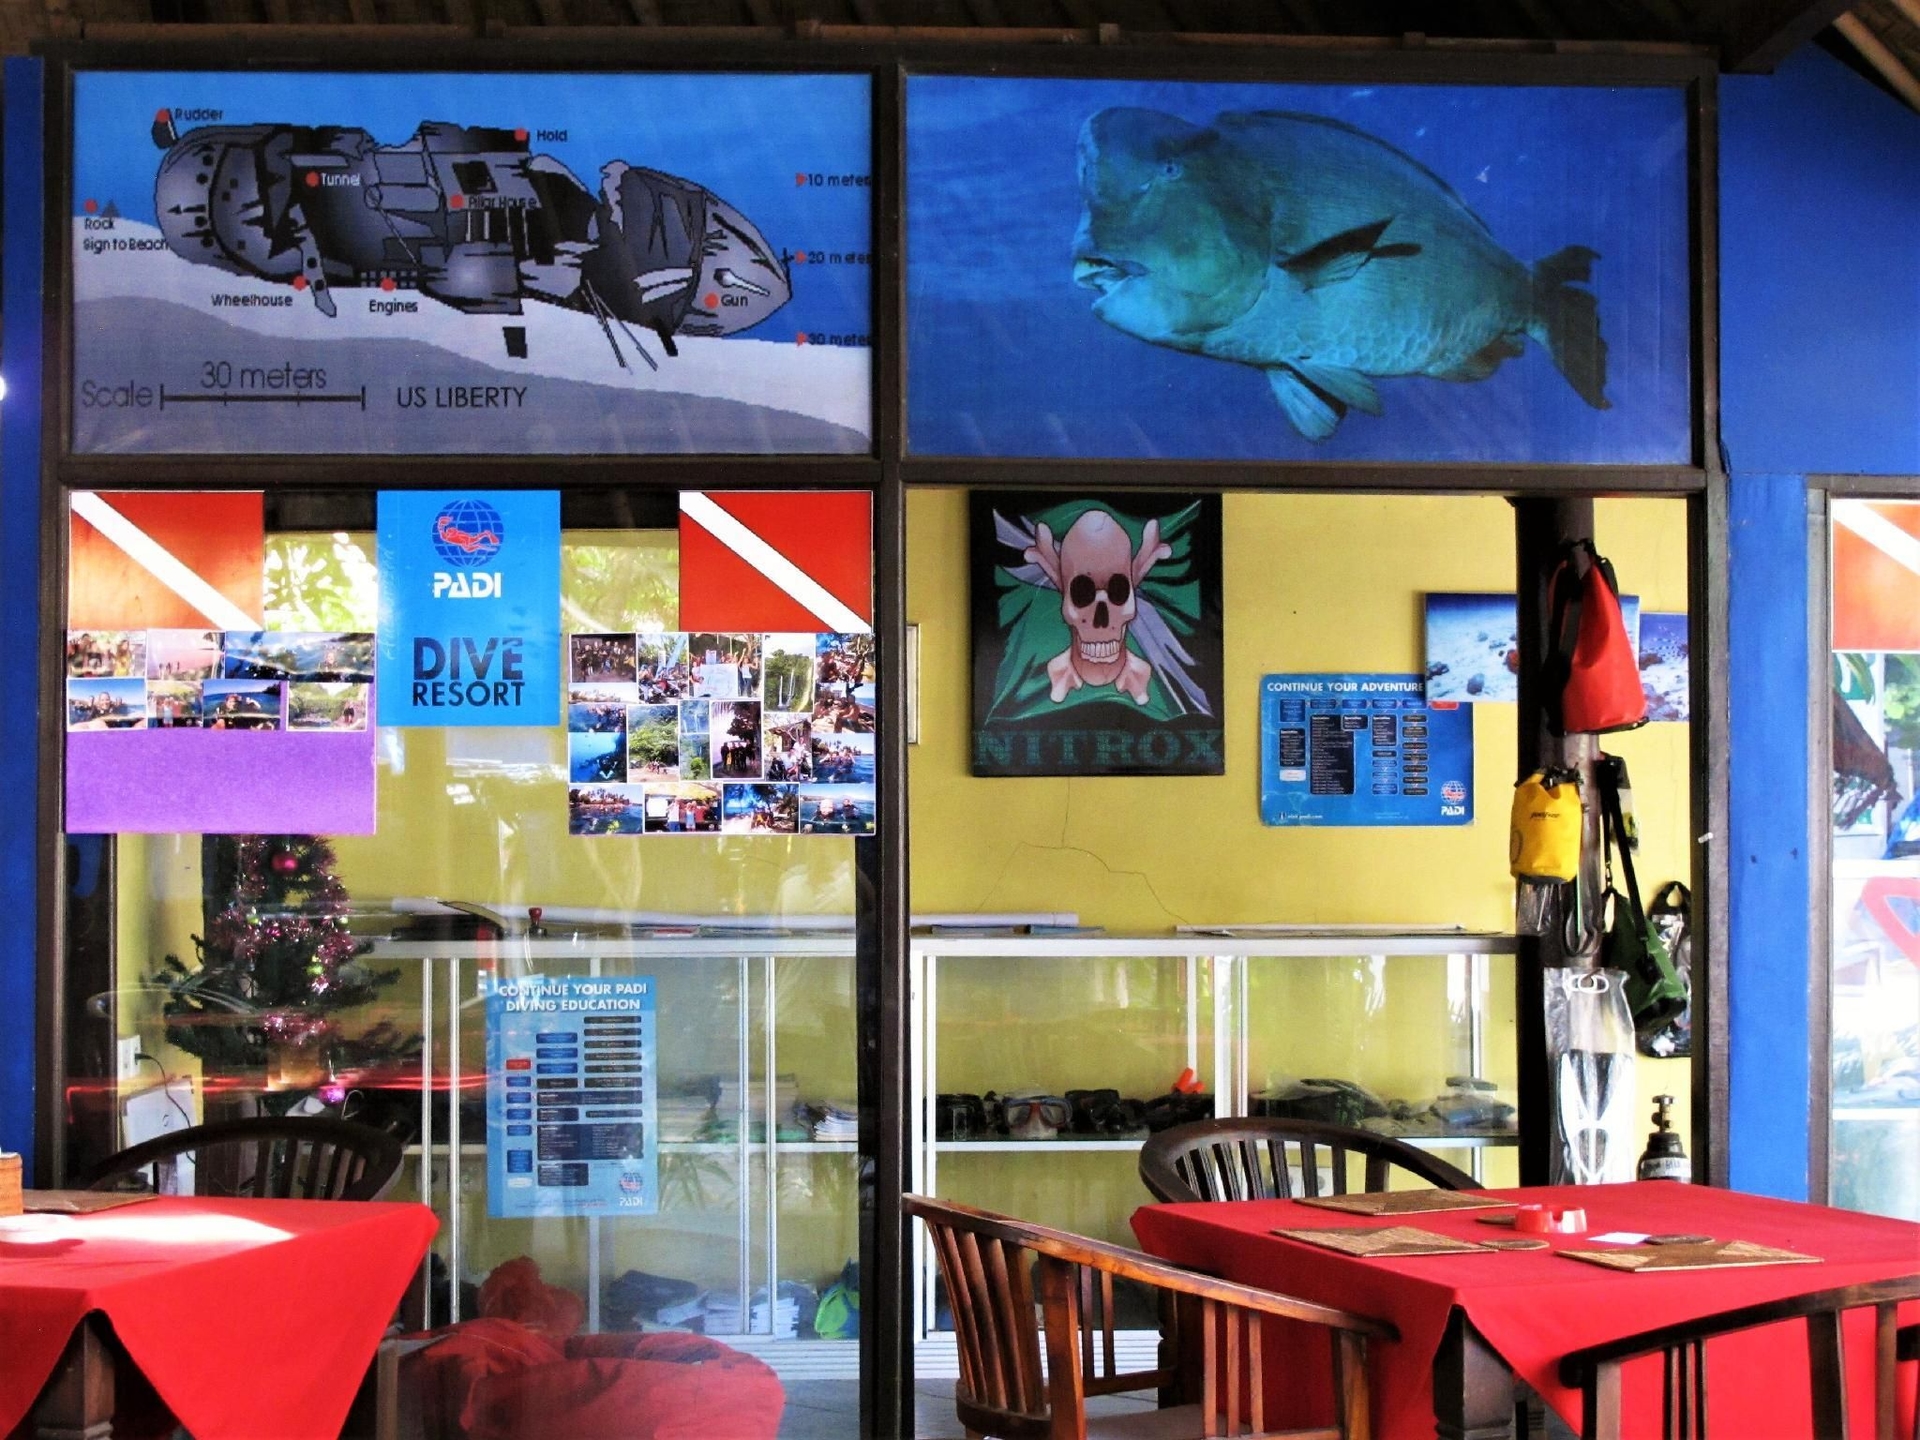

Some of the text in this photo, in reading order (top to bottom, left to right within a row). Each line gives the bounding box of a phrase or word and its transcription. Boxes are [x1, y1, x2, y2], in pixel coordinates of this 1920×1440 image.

[175, 108, 224, 121] Rudder
[536, 129, 568, 143] Hold
[320, 172, 361, 186] Tunnel
[808, 173, 824, 187] 10
[84, 217, 115, 230] Rock
[83, 236, 170, 254] Sign to Beach
[808, 250, 826, 265] 20
[211, 293, 293, 308] Wheelhouse
[368, 299, 419, 315] Engines
[720, 294, 749, 307] Gun
[808, 332, 826, 346] 30
[200, 361, 327, 389] 30 meters
[81, 380, 153, 408] Scale
[397, 387, 527, 408] US LIBERTY
[433, 572, 503, 599] PADI
[413, 637, 524, 681] DIVE
[412, 681, 526, 707] RESORT
[1266, 682, 1424, 692] CONTINUE YOUR ADVENTURE
[974, 729, 1225, 766] NITROX
[1440, 805, 1465, 816] PADI
[499, 982, 647, 997] CONTINUE YOUR PADI
[506, 999, 641, 1012] DIVING EDUCATION
[618, 1196, 643, 1207] PADI
